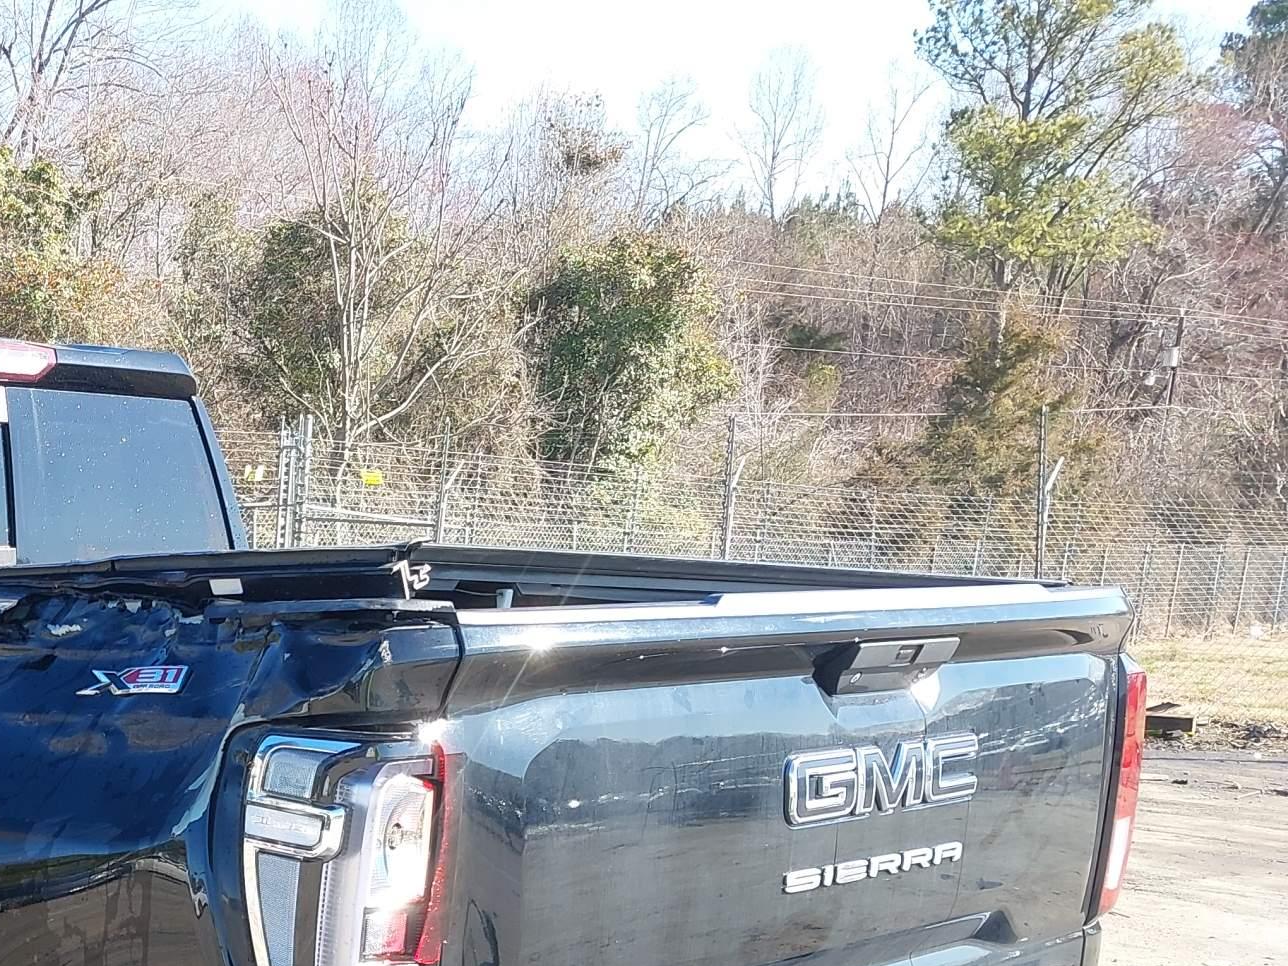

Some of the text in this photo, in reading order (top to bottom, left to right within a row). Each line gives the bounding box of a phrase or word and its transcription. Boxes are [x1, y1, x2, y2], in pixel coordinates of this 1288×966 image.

[75, 665, 189, 696] X31
[783, 732, 979, 831] GMC
[782, 840, 963, 895] SIERRA
